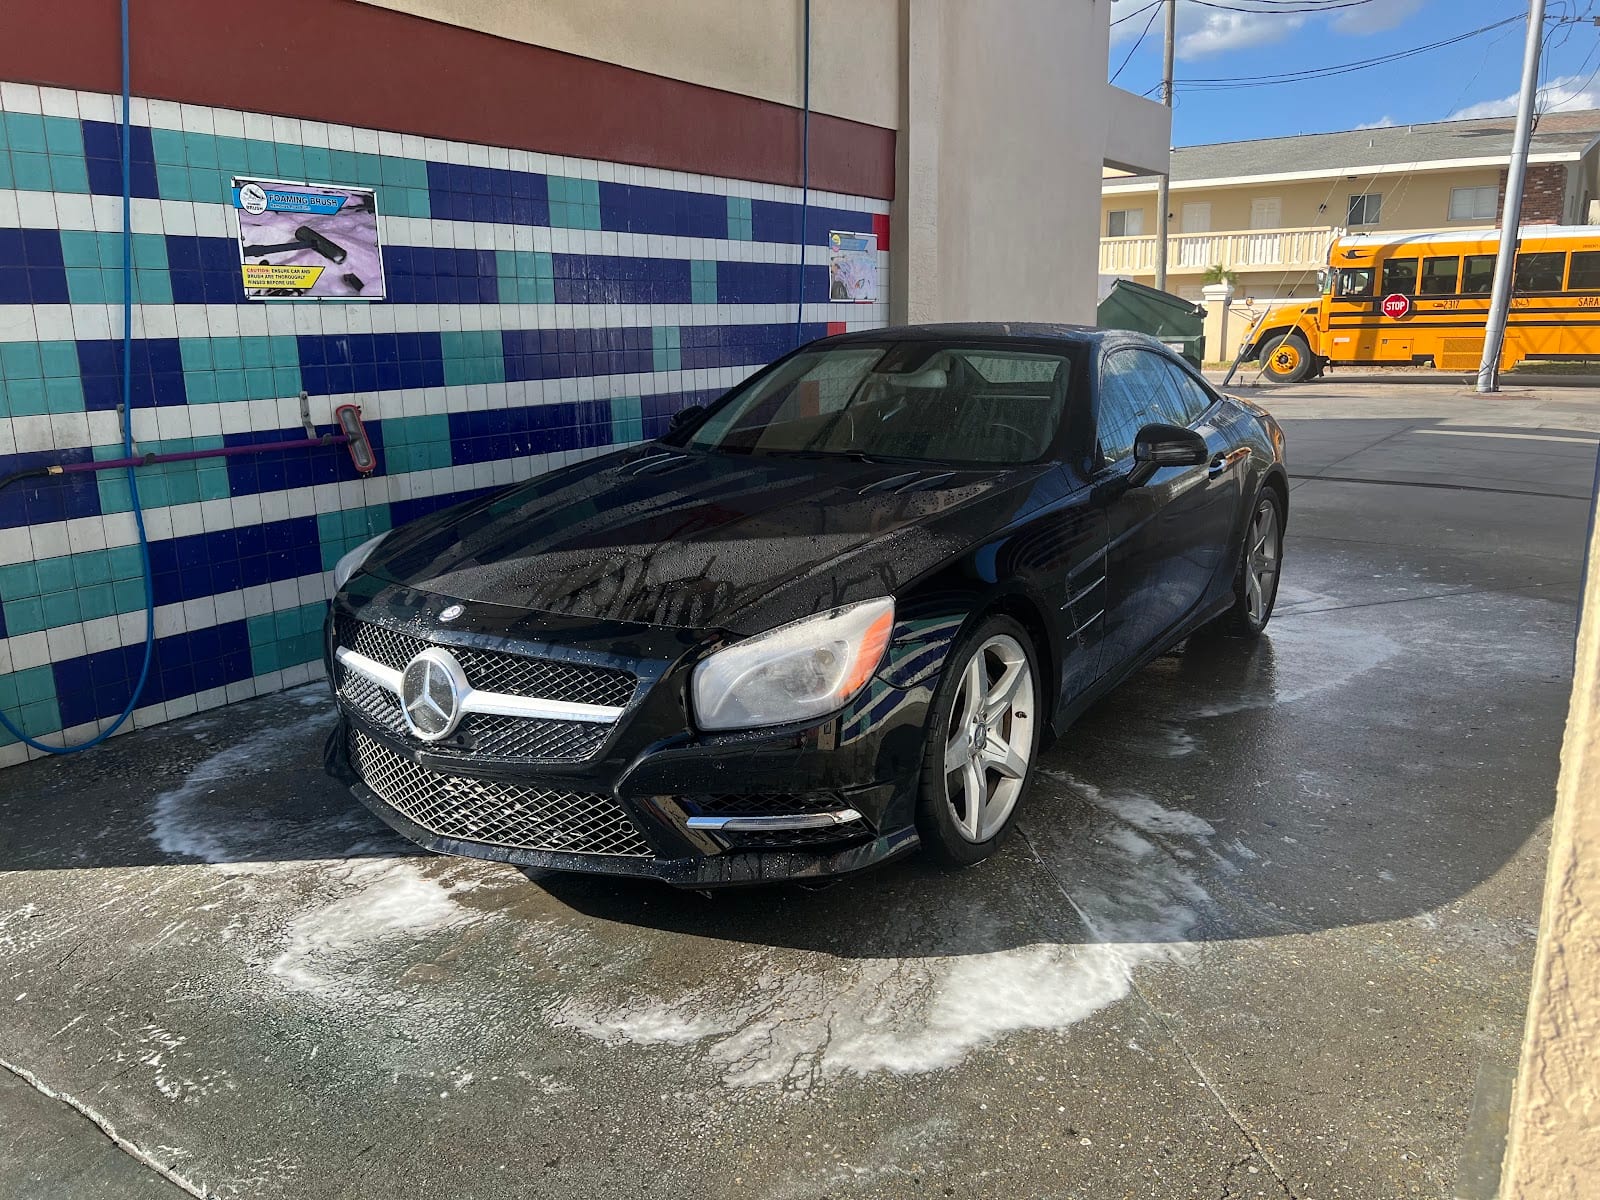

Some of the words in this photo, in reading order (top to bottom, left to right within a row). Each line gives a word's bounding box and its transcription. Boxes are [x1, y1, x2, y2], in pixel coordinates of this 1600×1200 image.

[269, 194, 308, 205] FOAMING
[310, 197, 338, 207] BRUSH
[1385, 301, 1406, 311] STOP
[1443, 300, 1460, 309] 2317
[1577, 297, 1600, 307] SARA
